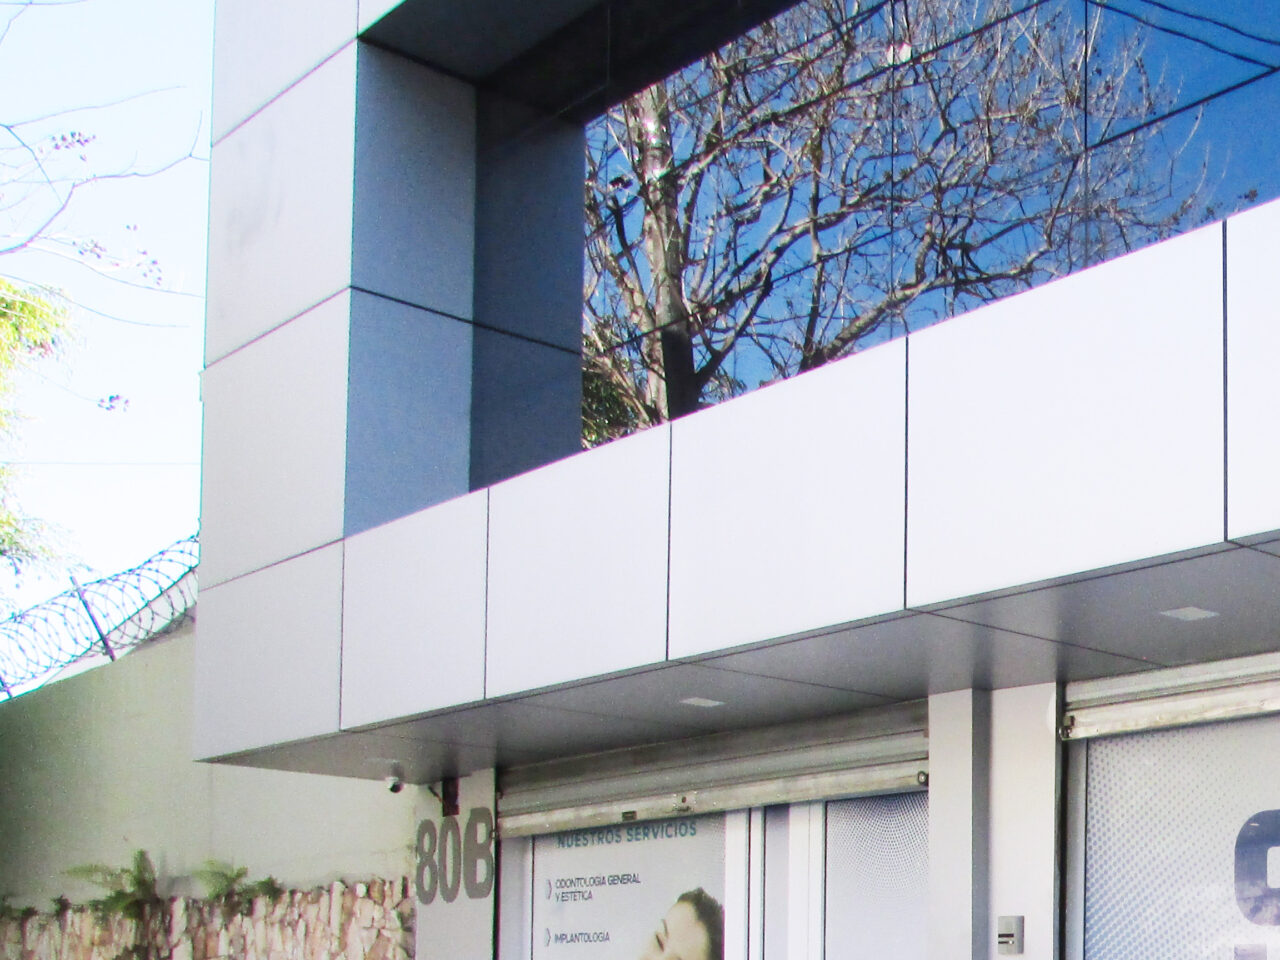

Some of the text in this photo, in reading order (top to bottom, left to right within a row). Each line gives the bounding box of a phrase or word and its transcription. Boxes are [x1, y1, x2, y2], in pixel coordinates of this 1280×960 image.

[556, 822, 697, 848] NUESTROS SERVICIOS
[607, 873, 641, 885] GENERAL
[554, 891, 560, 902] Y
